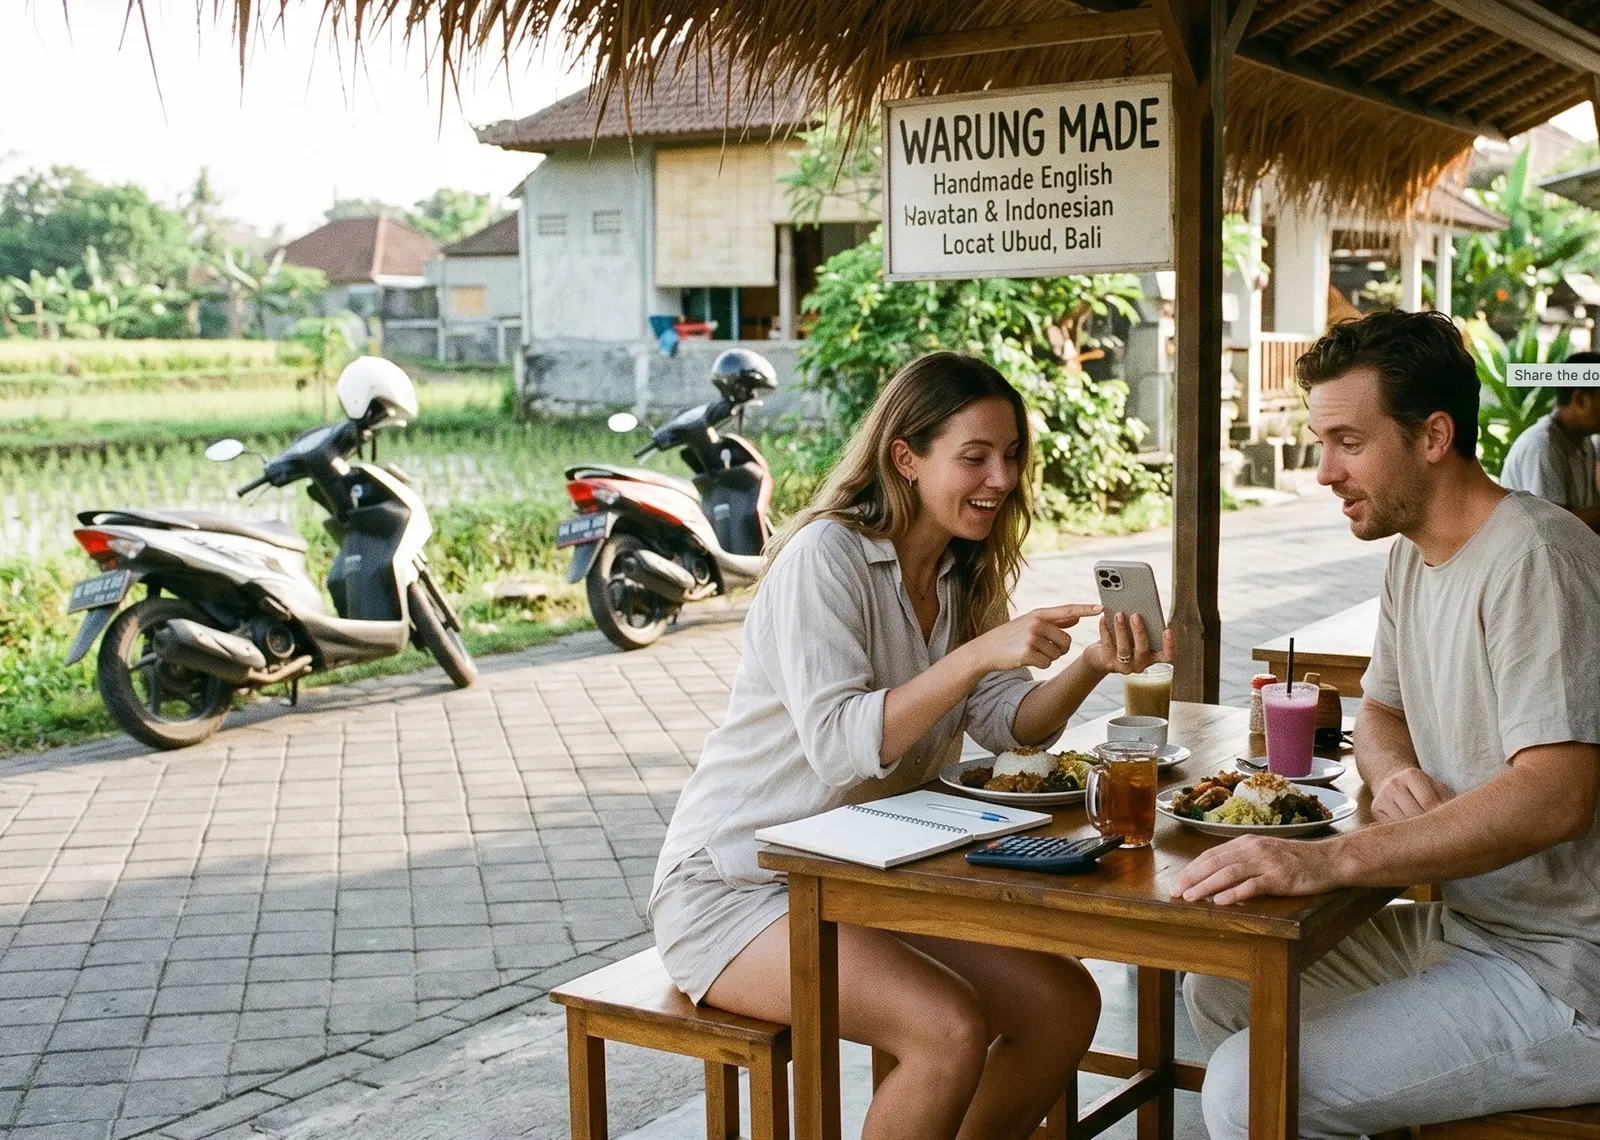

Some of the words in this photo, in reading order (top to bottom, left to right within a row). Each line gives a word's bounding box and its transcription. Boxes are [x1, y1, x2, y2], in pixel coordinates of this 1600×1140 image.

[899, 107, 1045, 165] WARUNG
[1059, 97, 1159, 155] MADE
[934, 168, 1034, 195] Handmade
[1041, 162, 1113, 194] English
[985, 200, 998, 222] &
[1006, 195, 1114, 222] Indonesian
[943, 232, 995, 255] Locat
[1002, 228, 1058, 255] Ubud,
[1066, 225, 1102, 250] Bali
